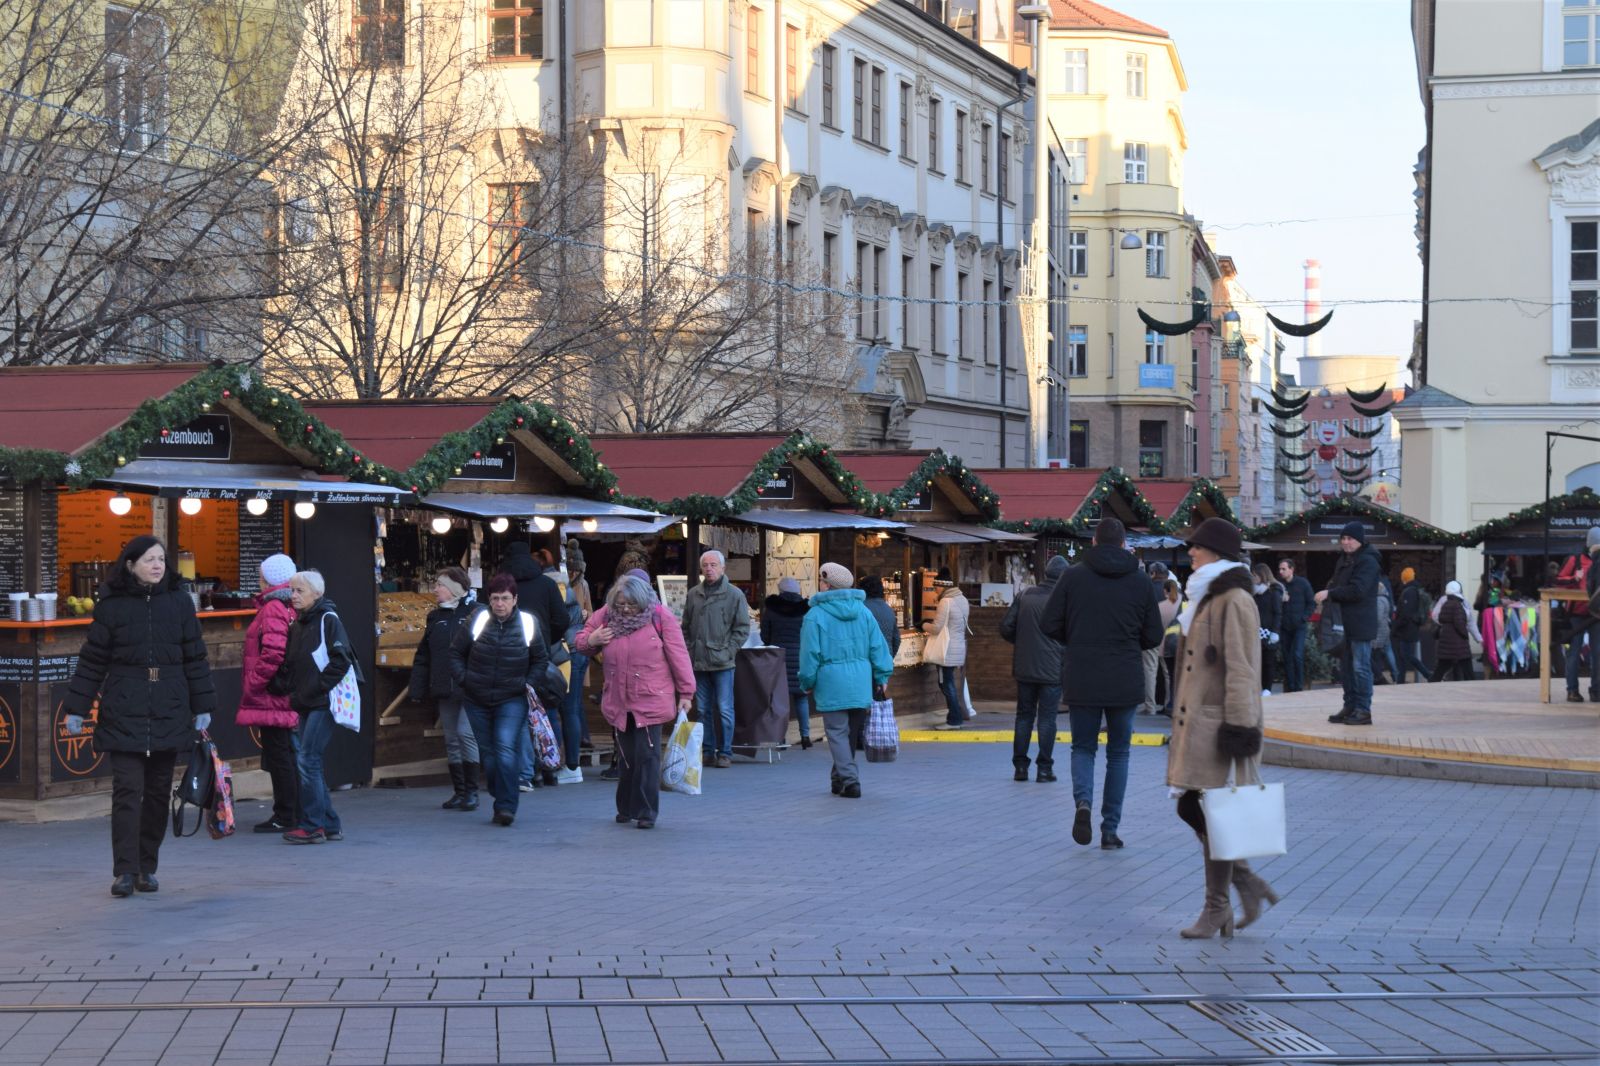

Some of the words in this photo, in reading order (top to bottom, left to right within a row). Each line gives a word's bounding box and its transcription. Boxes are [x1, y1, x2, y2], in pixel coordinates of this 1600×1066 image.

[186, 489, 211, 499] Svařák
[220, 489, 238, 499] Punč
[256, 490, 273, 499] Mošt
